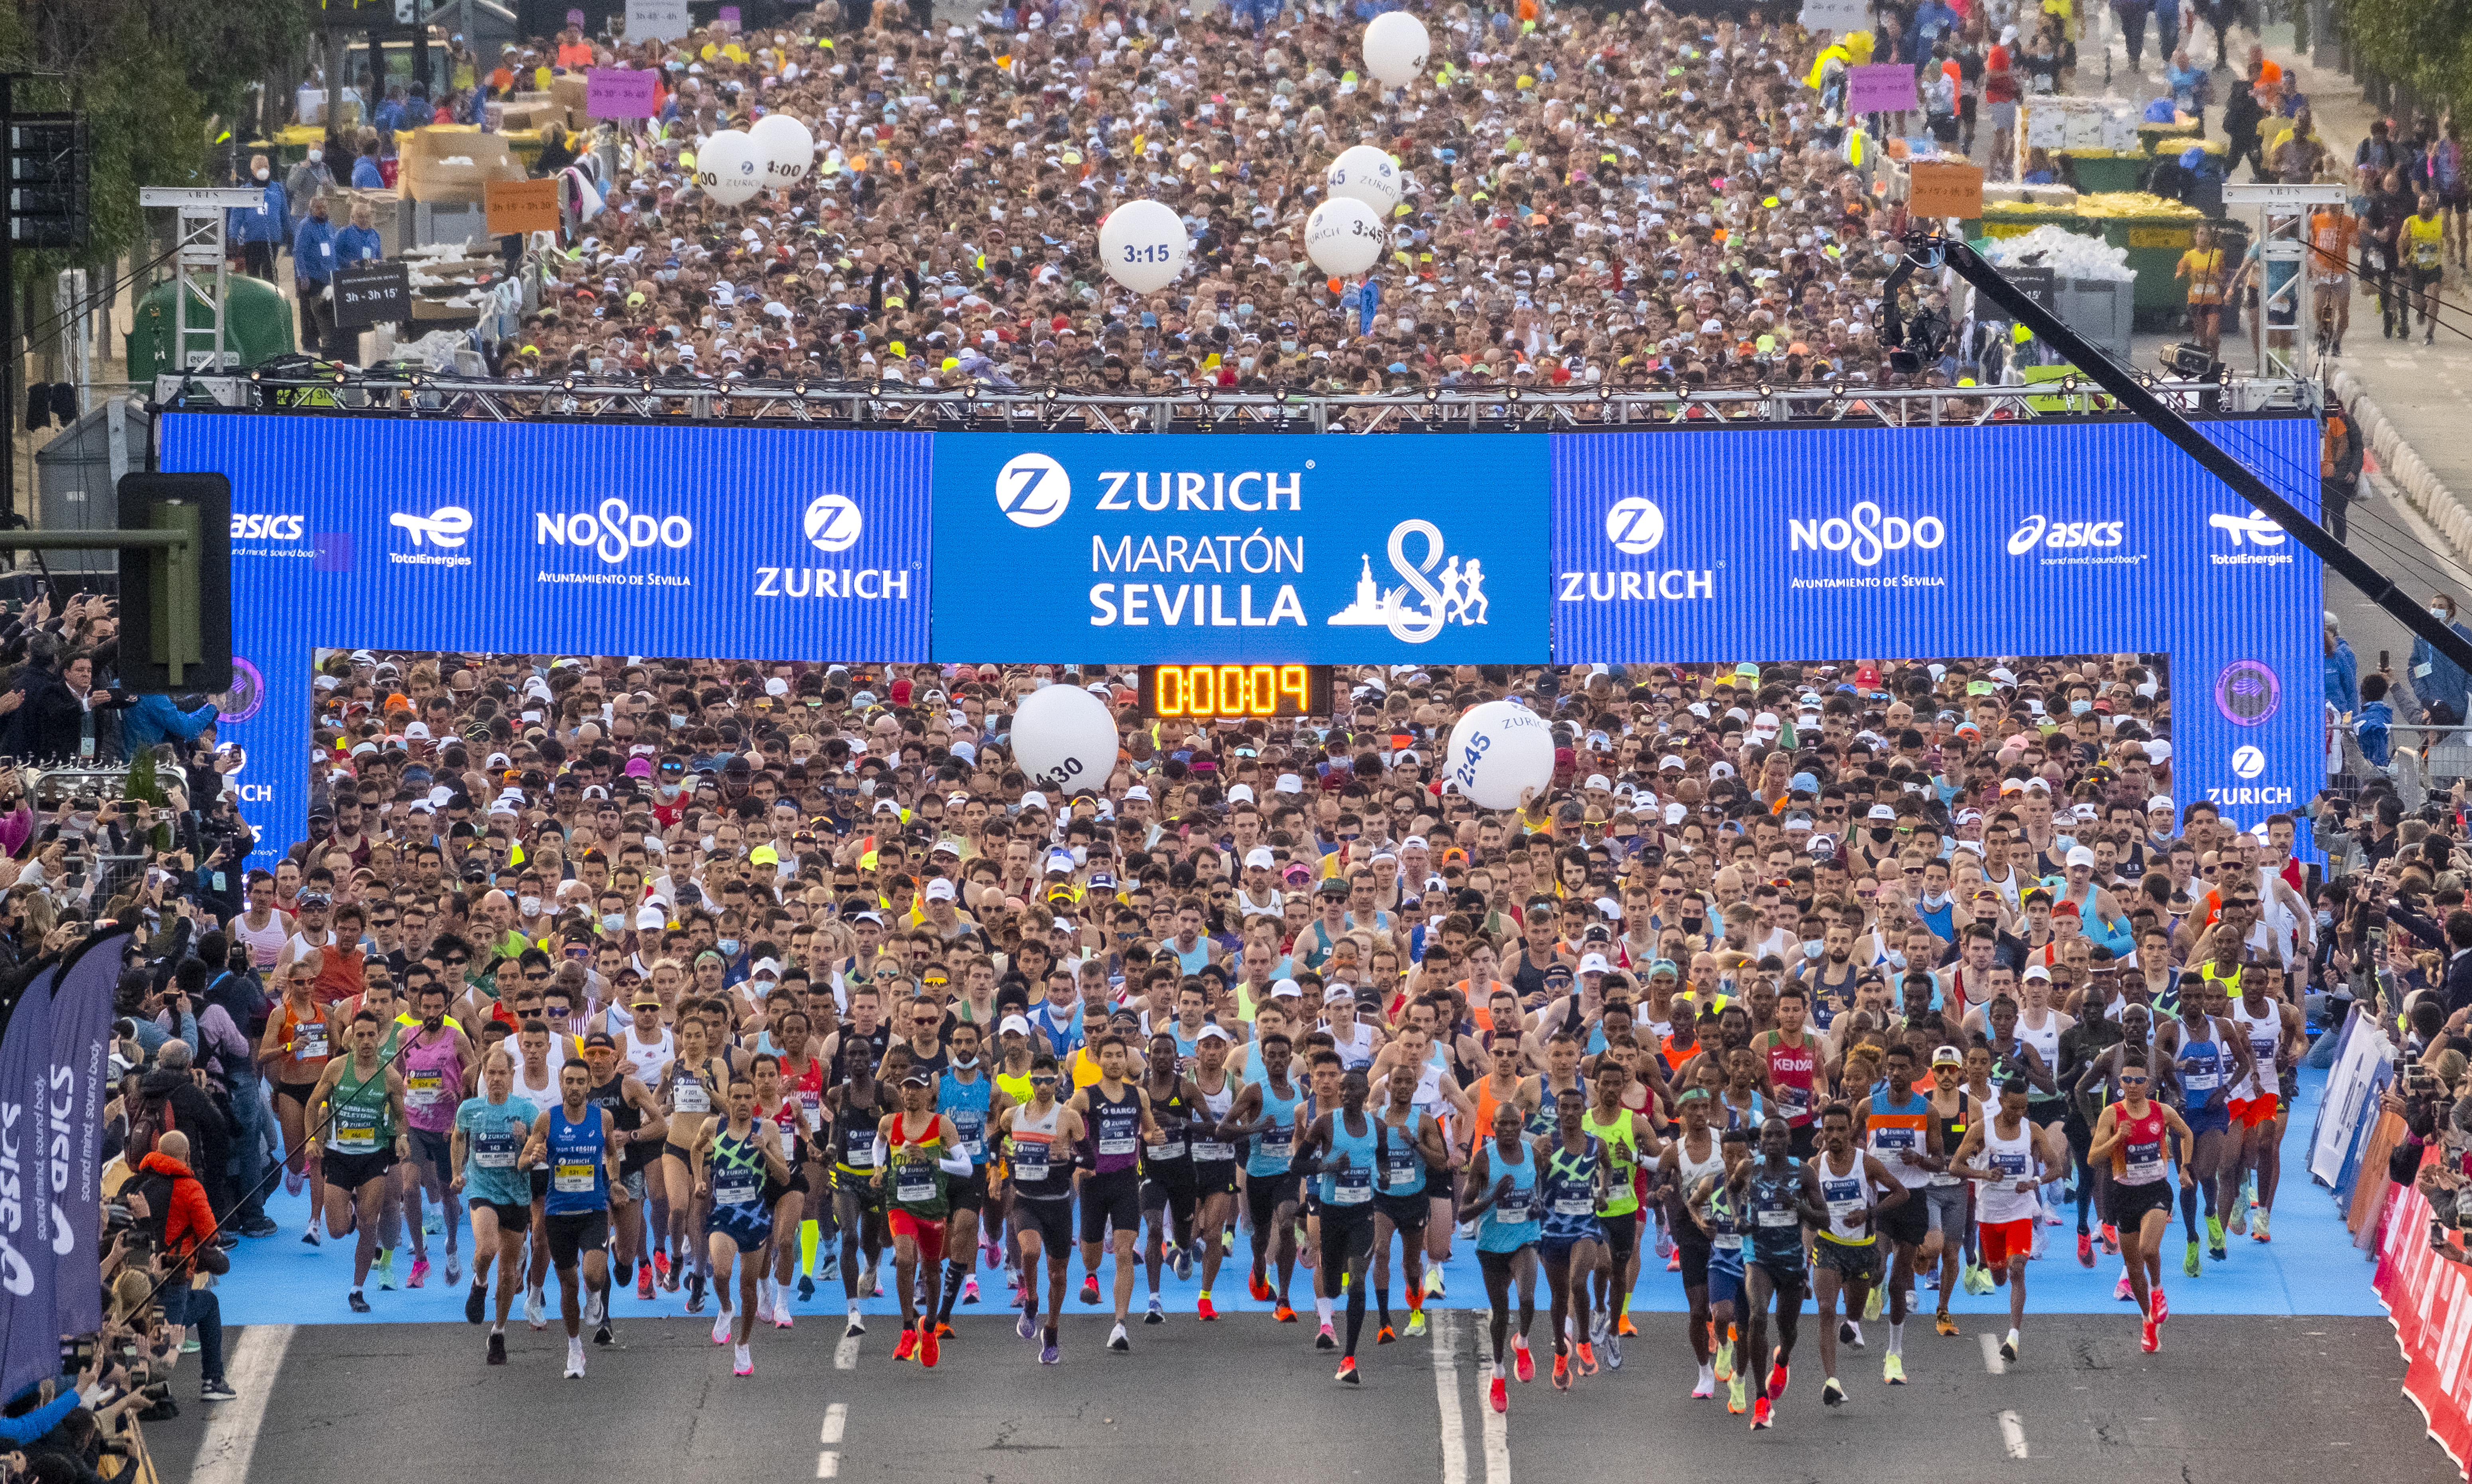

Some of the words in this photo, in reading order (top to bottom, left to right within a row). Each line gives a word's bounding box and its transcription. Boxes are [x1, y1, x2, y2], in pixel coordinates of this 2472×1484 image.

[1352, 219, 1382, 244] 3:45
[1124, 244, 1169, 262] 3:15
[346, 292, 359, 302] 3h
[368, 289, 381, 300] 3h
[1096, 472, 1301, 511] ZURICH
[231, 514, 304, 540] asics
[2046, 522, 2124, 547] asics
[389, 553, 471, 568] TotalEnergies
[1093, 527, 1303, 573] MARATÓN
[2210, 553, 2293, 567] TotalEnergies
[754, 567, 908, 599] ZURICH
[1559, 570, 1712, 601] ZURICH
[1090, 583, 1307, 626] SEVILLA
[1157, 666, 1307, 714] 0:00:09
[1456, 731, 1491, 788] 2:45
[2207, 787, 2291, 805] ZURICH
[90, 1038, 102, 1075] body
[1773, 1058, 1813, 1072] KENYA
[85, 1075, 97, 1119] sound
[50, 1064, 73, 1193] asics
[81, 1159, 91, 1203] sound
